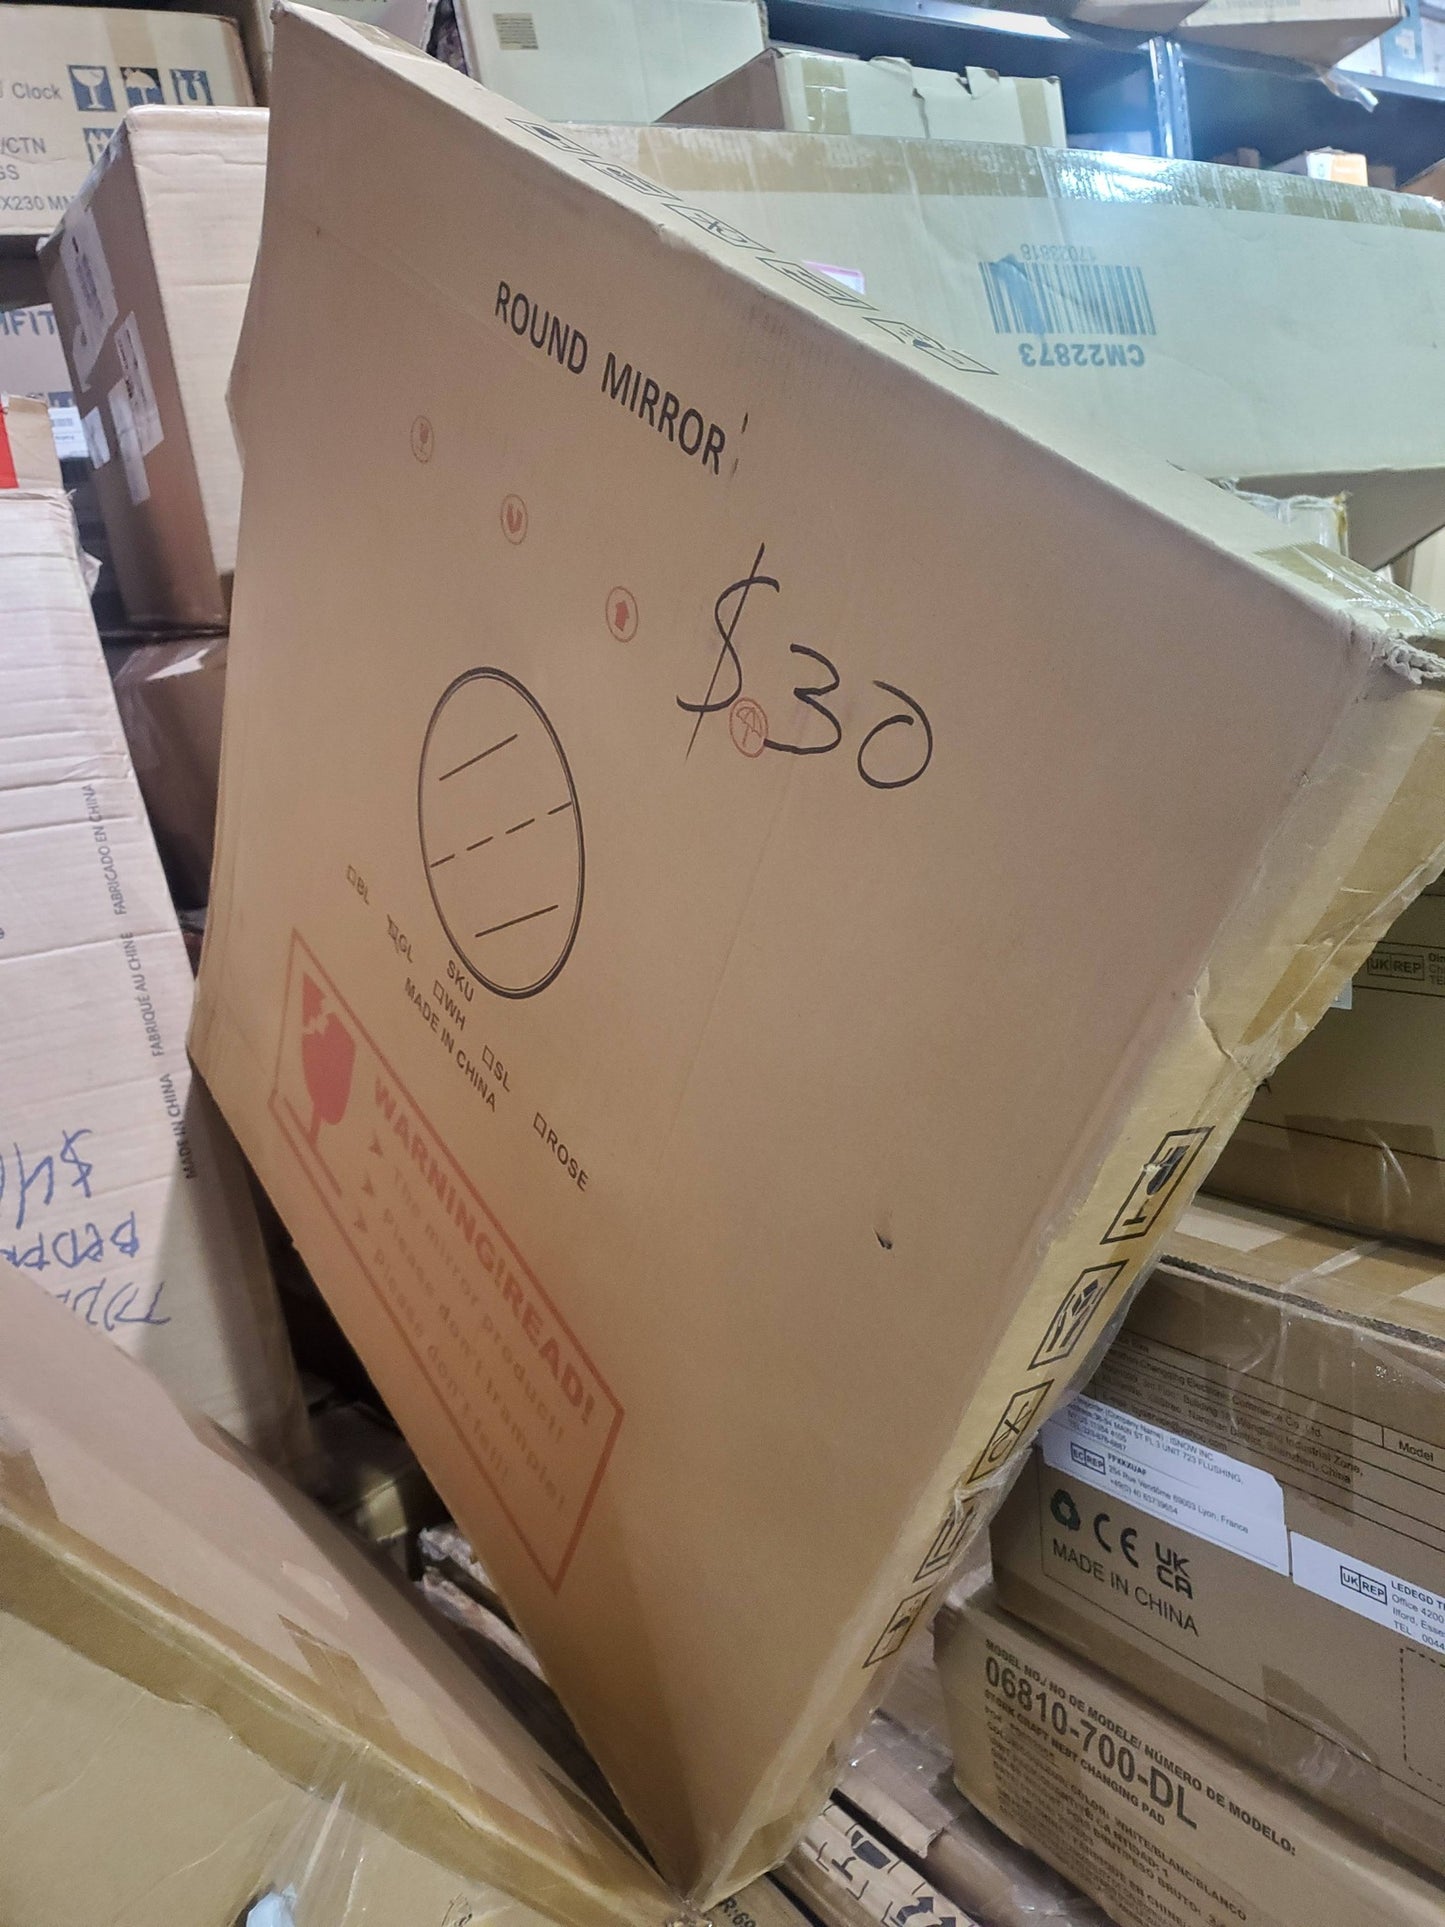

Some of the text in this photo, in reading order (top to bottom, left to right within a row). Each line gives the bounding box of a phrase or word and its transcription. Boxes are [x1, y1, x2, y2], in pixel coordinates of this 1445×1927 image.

[12, 82, 62, 100] Clock
[1018, 342, 1146, 368] CM22873
[495, 280, 726, 476] ROUND MIRROR
[676, 542, 933, 790] $30
[81, 783, 127, 916] FABRICADO EN CHINA
[120, 931, 142, 973] CHINE
[1393, 960, 1422, 974] REP
[131, 974, 148, 992] AU
[447, 960, 474, 1002] SKU
[404, 977, 496, 1112] MADE IN CHINA
[160, 1073, 182, 1119] CHINA
[171, 1121, 186, 1138] IN
[546, 1129, 590, 1193] ROSE
[1399, 1438, 1435, 1463] Model
[1052, 1538, 1199, 1638] MADE IN CHINA
[1343, 1572, 1385, 1597] UK REP
[1391, 1593, 1419, 1613] Office
[1394, 1620, 1412, 1636] TEL
[986, 1656, 1197, 1830] 06810-700-DL
[1069, 1694, 1086, 1713] DE
[1206, 1785, 1226, 1808] DE
[1229, 1801, 1296, 1856] MODELO:
[1141, 1802, 1166, 1826] PAD
